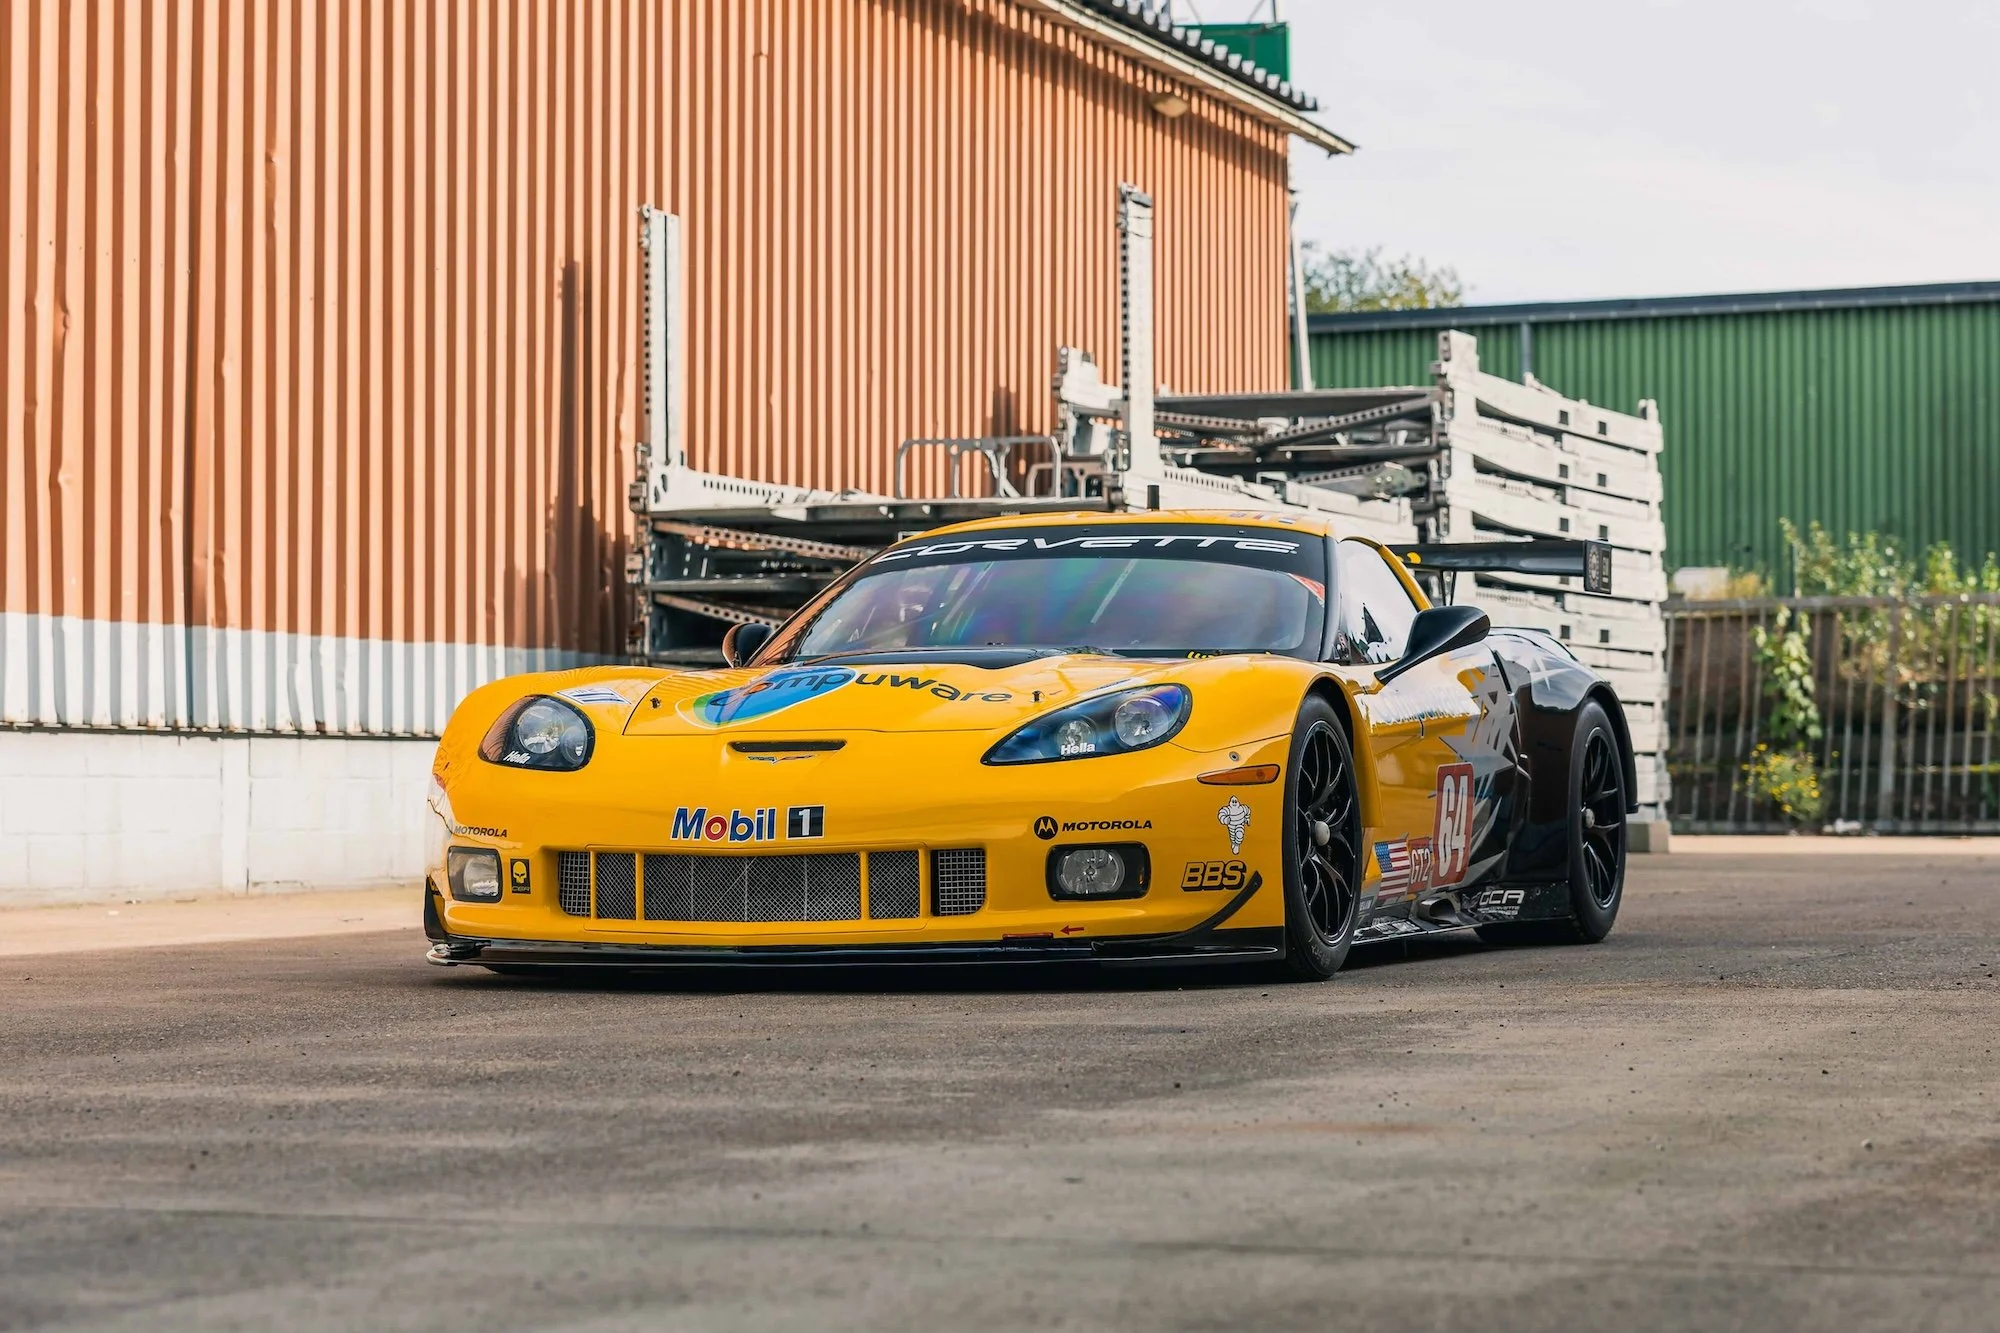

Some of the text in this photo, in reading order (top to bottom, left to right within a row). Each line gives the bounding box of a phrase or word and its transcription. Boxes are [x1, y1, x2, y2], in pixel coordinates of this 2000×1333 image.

[870, 536, 1300, 565] CORVETTE
[1060, 742, 1096, 756] Hella
[454, 825, 508, 838] MOTOROLA
[670, 806, 777, 843] Mobil
[1062, 819, 1153, 832] MOTOROLA
[1438, 774, 1469, 878] 64
[1181, 859, 1247, 892] BBS
[1411, 847, 1432, 885] GT2
